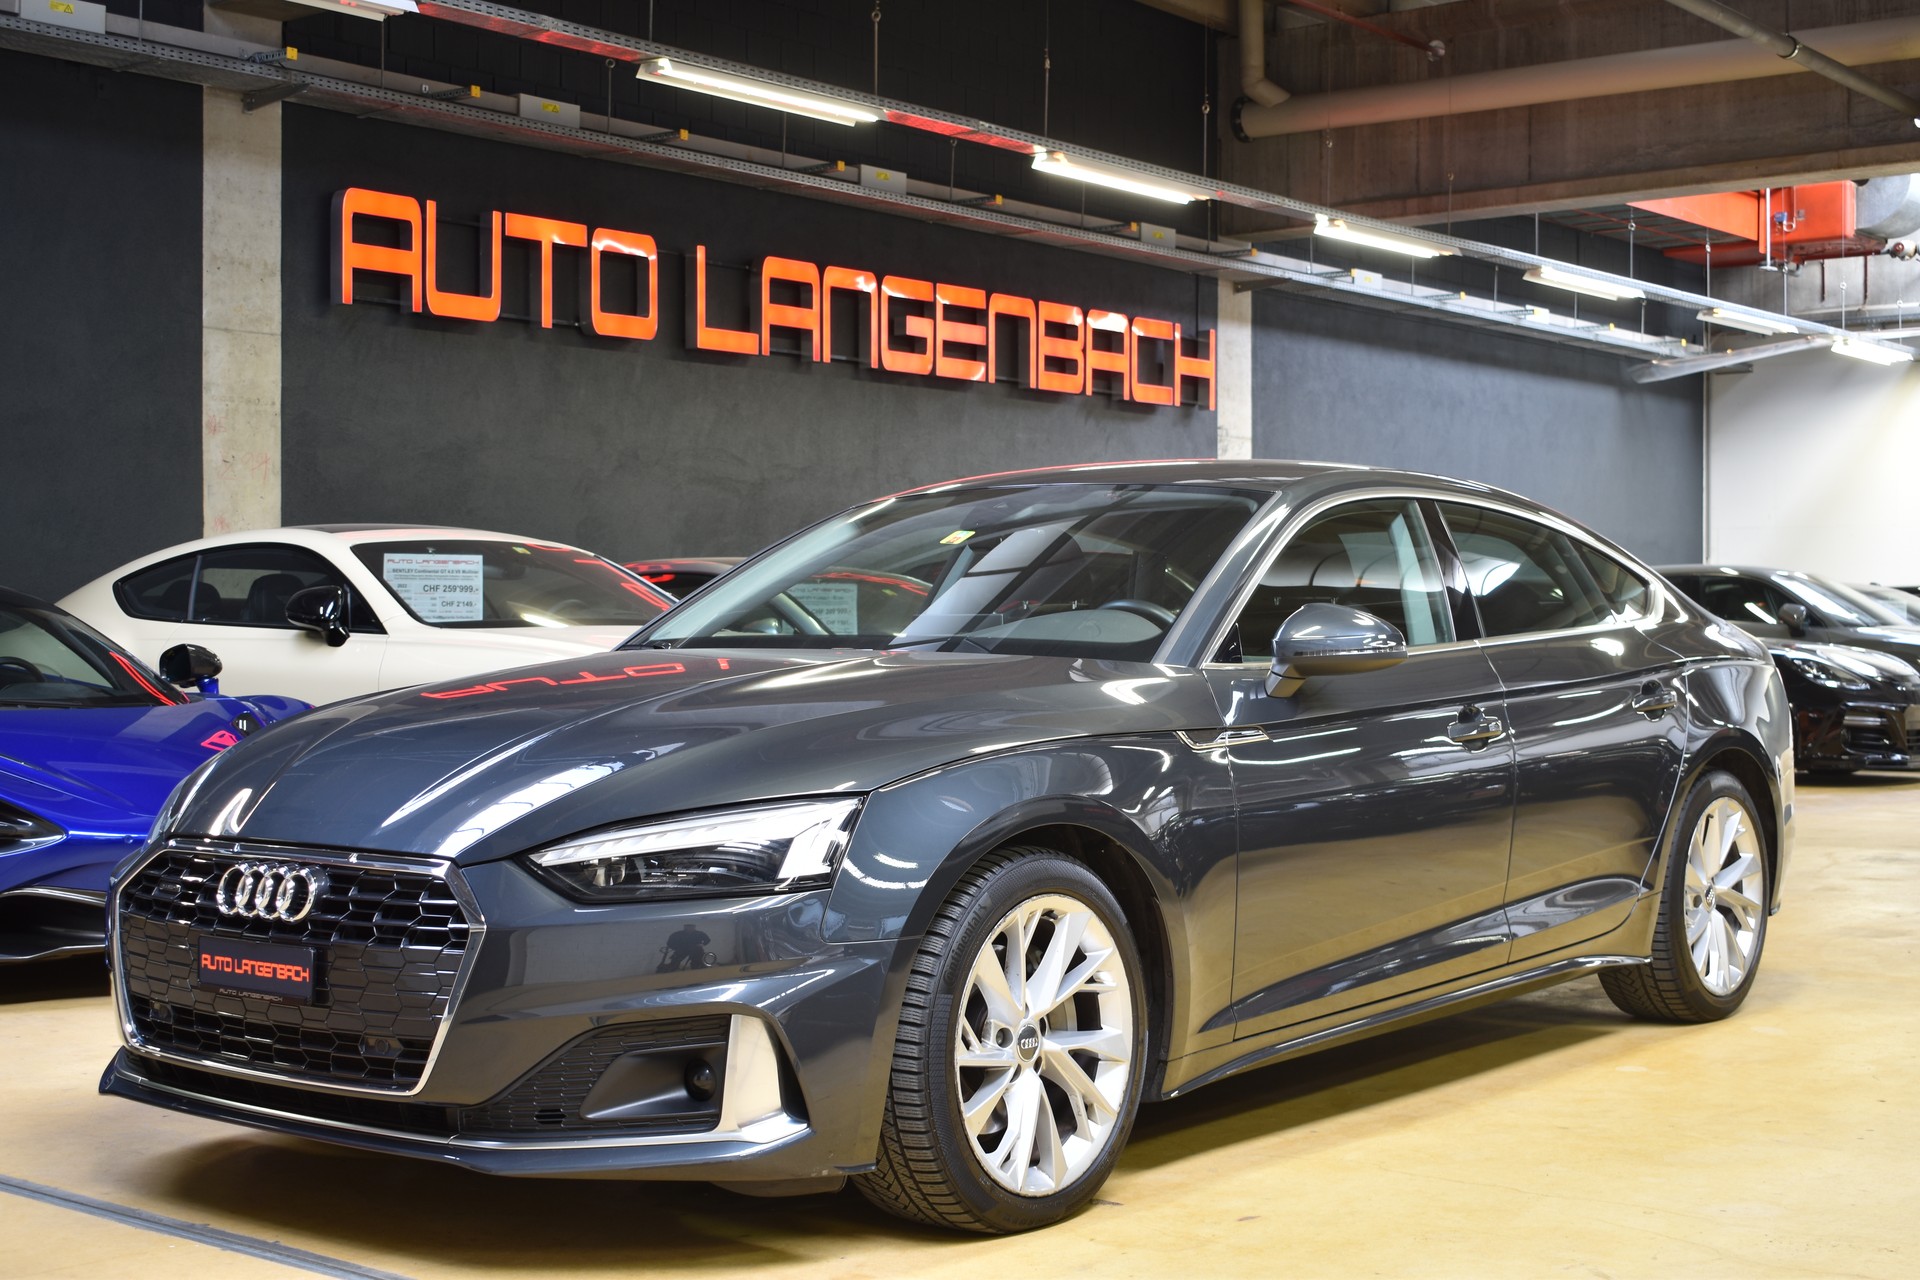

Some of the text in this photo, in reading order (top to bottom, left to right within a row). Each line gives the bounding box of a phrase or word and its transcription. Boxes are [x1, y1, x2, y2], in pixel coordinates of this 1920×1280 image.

[340, 187, 1216, 411] AUTO LANGENBACH
[423, 585, 441, 593] CHF
[201, 953, 310, 983] AUTO LANGENBACH
[219, 988, 284, 1003] AUTO LANGENBACH
